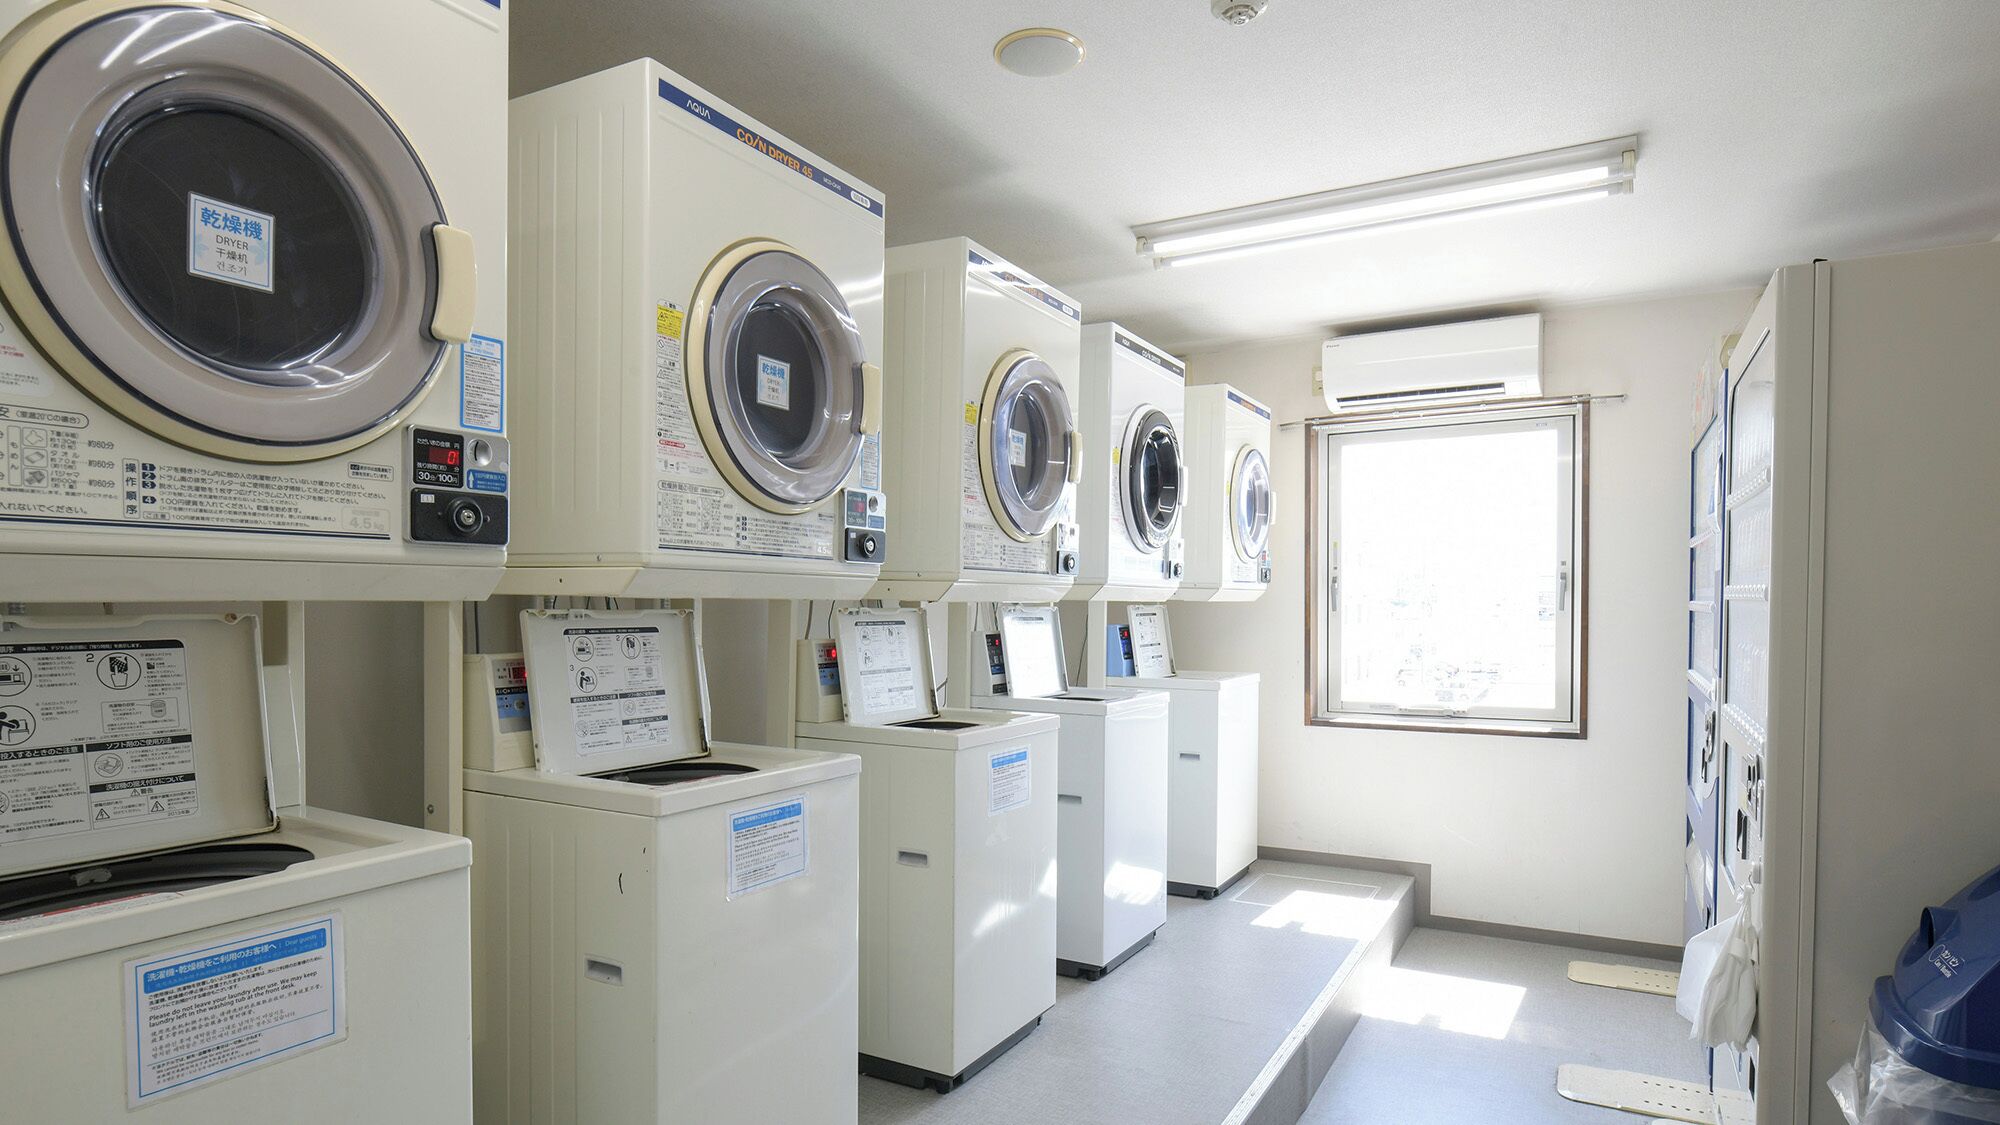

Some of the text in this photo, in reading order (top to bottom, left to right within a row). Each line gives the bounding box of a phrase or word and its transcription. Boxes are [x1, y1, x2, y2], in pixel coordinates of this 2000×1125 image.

[686, 99, 711, 120] AQUA
[736, 127, 813, 179] COIN DRYER 45
[200, 207, 263, 240] 乾燥機
[216, 234, 249, 251] DRYER
[447, 451, 456, 464] 0
[86, 653, 94, 662] 2
[569, 664, 575, 672] 3
[149, 1011, 170, 1021] Please
[194, 1000, 211, 1008] leave
[212, 996, 227, 1006] your
[228, 988, 251, 1000] laundry
[252, 984, 266, 992] after
[291, 974, 303, 983] may
[304, 970, 318, 979] keep
[149, 1018, 174, 1028] laundry
[176, 1013, 188, 1022] left
[196, 1007, 207, 1015] the
[208, 1000, 234, 1011] washing
[254, 990, 264, 998] the
[265, 986, 280, 996] front
